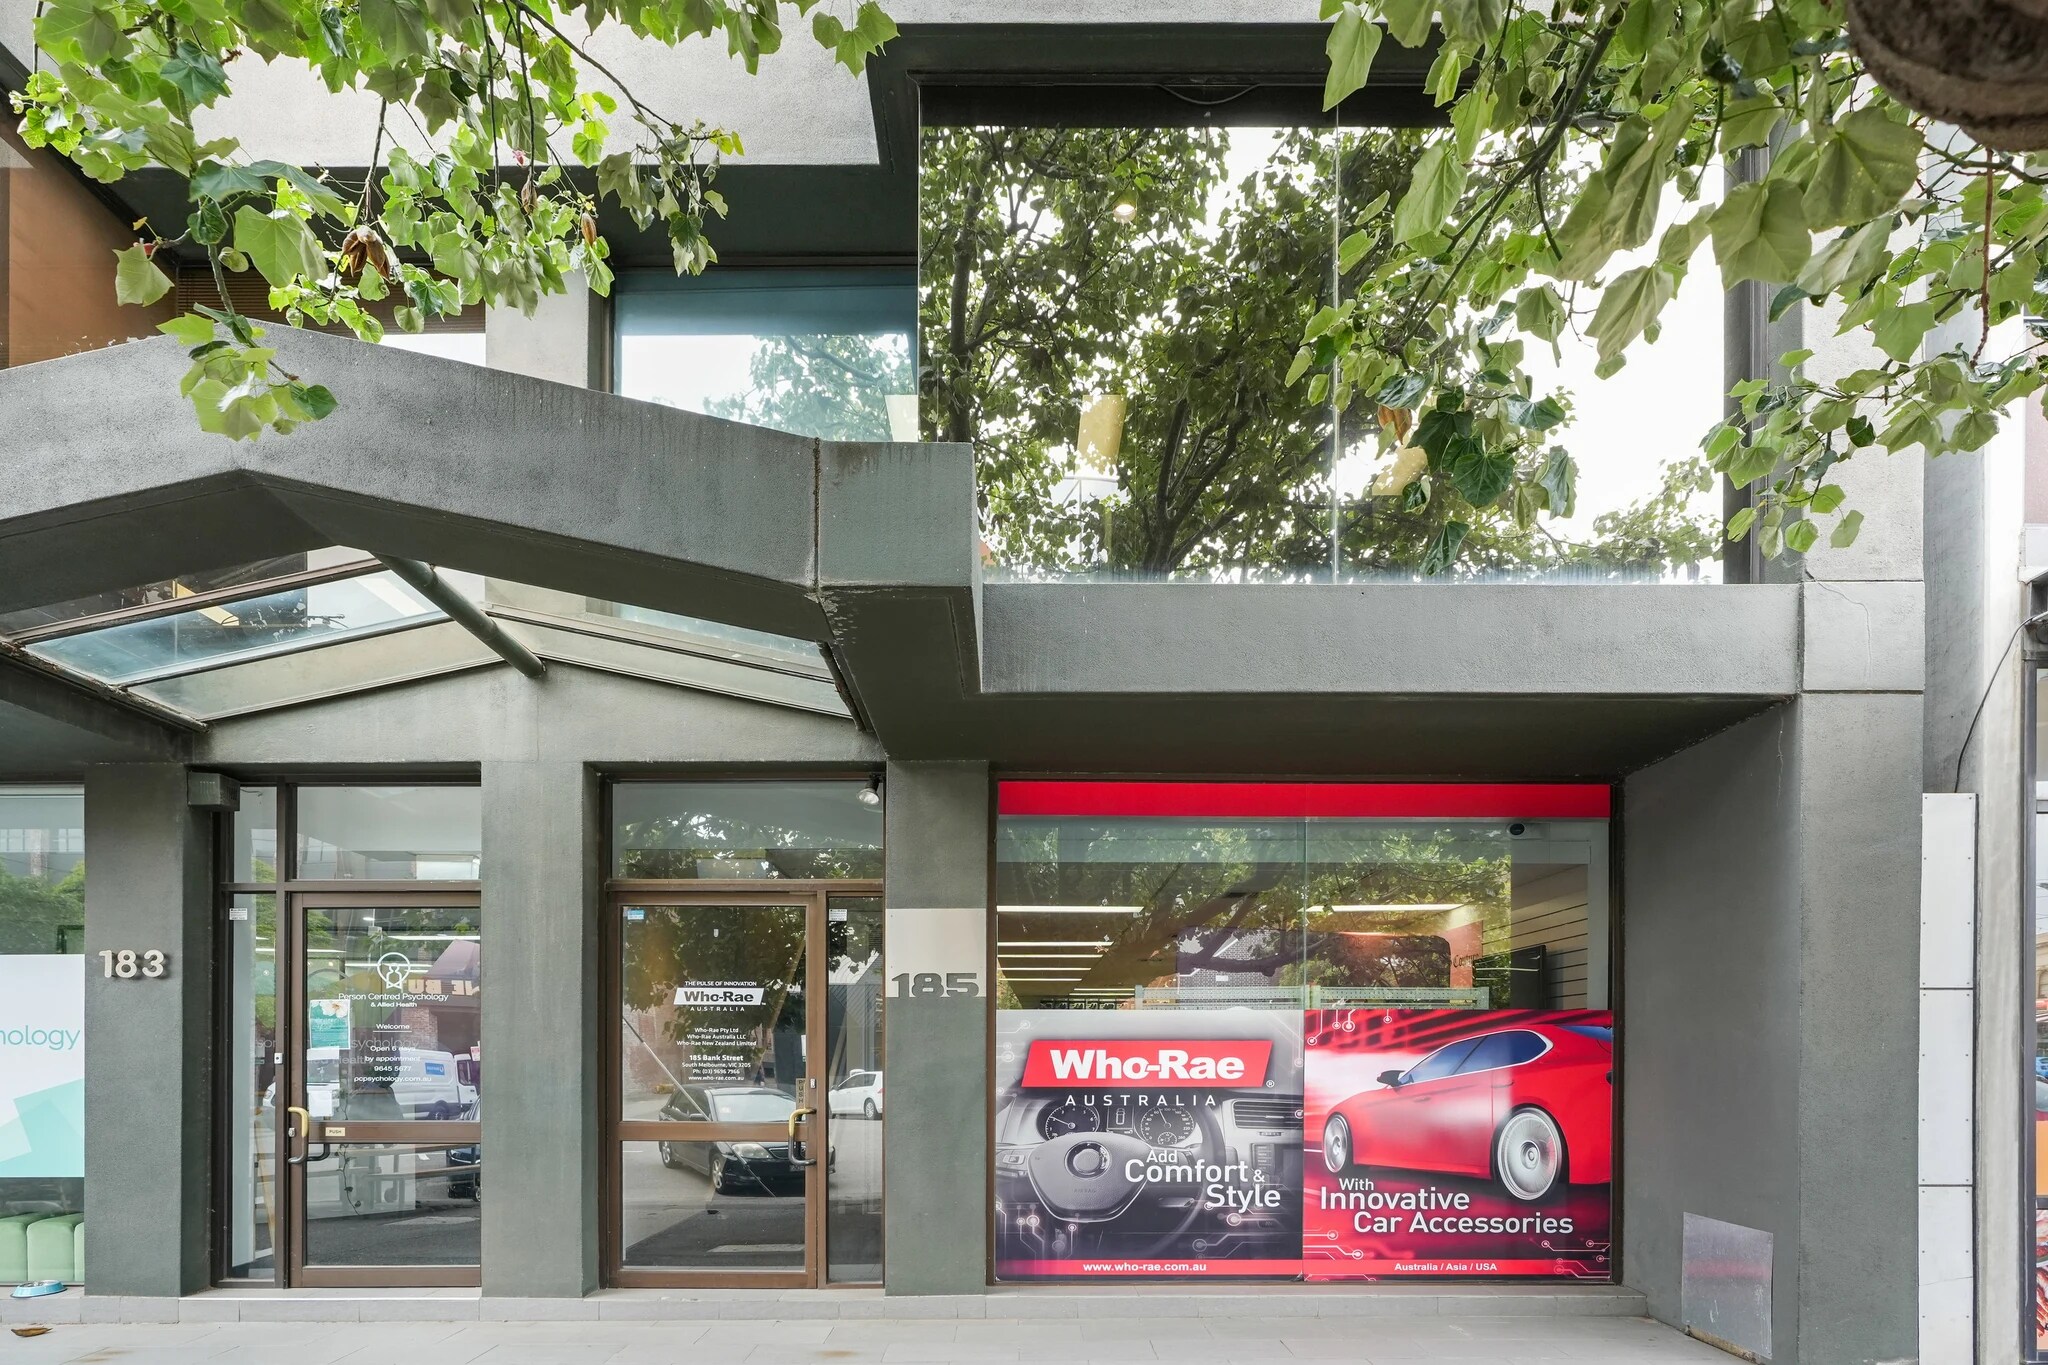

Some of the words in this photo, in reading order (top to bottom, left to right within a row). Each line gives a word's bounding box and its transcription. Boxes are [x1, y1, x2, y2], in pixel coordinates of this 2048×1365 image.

[98, 949, 165, 979] 183
[891, 972, 979, 998] 185
[402, 993, 449, 1002] Psychology
[683, 990, 754, 1002] Who-Rae
[351, 1037, 419, 1050] sychology
[1049, 1049, 1245, 1080] Who-Rae
[353, 1075, 432, 1083] pcpsychology.com.au
[1065, 1094, 1216, 1106] AUSTRALIA
[1146, 1150, 1178, 1163] Add
[1125, 1159, 1248, 1183] Comfort
[1253, 1169, 1265, 1183] &
[1339, 1178, 1374, 1191] With
[1206, 1184, 1281, 1213] Style
[1320, 1186, 1470, 1210] Innovative
[1353, 1211, 1403, 1233] Car
[1408, 1211, 1574, 1233] Accessories
[1083, 1262, 1207, 1272] www.who-rae.com.au
[1394, 1263, 1438, 1271] Australia
[1445, 1263, 1468, 1271] Asia
[1475, 1263, 1498, 1271] USA
